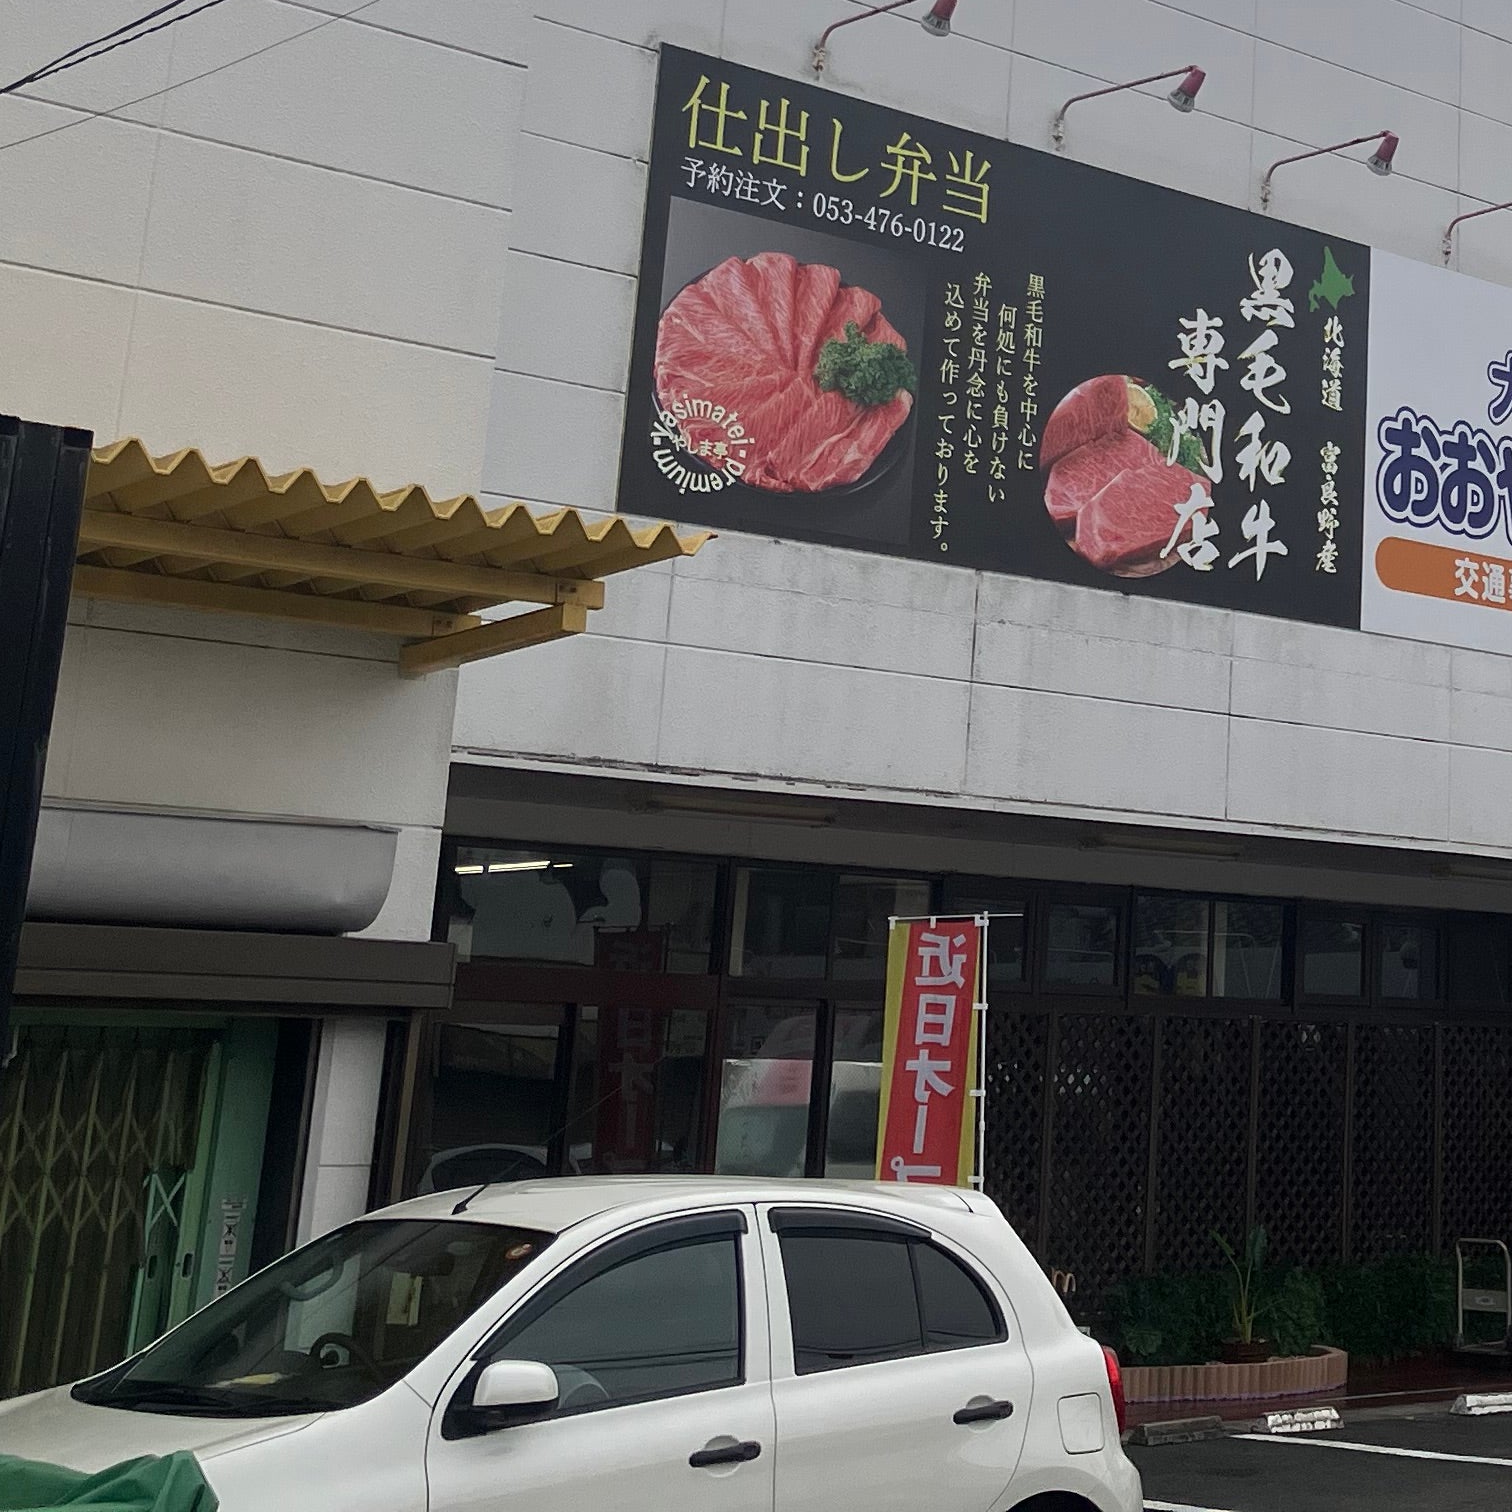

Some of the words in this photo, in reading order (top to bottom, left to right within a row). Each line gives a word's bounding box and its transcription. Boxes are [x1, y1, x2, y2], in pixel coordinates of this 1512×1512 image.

[682, 74, 991, 224] 仕出し弁当
[650, 393, 756, 440] yasimatei
[672, 434, 729, 460] やしま亭
[931, 283, 965, 553] 込めて作っております。
[963, 271, 993, 475] 弁当を丹念に心を
[988, 303, 1018, 503] 何処にも負けない
[1017, 274, 1045, 471] 黒毛和牛を中心に
[1159, 308, 1230, 573] 専門店
[1228, 248, 1296, 582] 黒毛和牛
[1321, 316, 1344, 412] 北海道
[653, 448, 746, 495] premium
